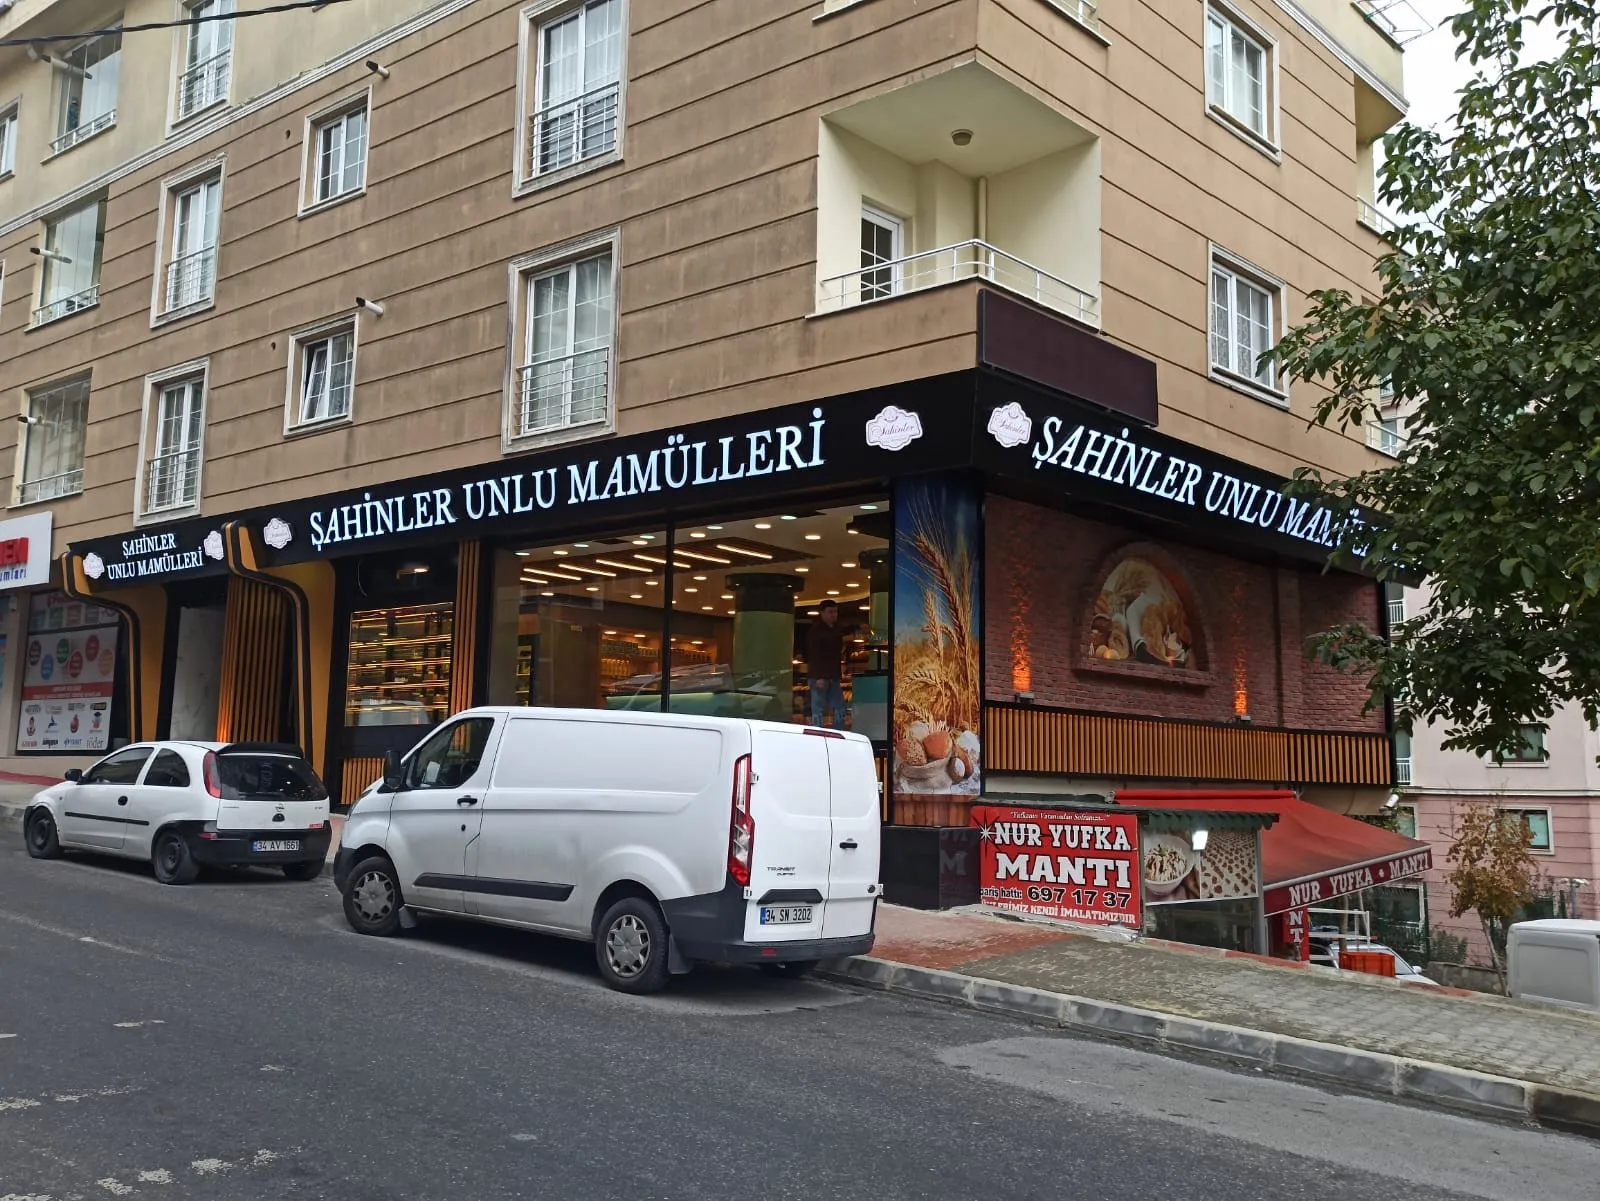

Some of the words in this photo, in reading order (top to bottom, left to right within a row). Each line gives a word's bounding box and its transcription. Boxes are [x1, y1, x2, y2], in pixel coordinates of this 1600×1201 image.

[310, 492, 458, 551] ŞAHİNLER
[462, 468, 557, 520] UNLU
[567, 407, 826, 504] MAMÜLLERİ
[1032, 416, 1203, 505] ŞAHİNLER
[1204, 471, 1282, 528] UNLU
[122, 533, 176, 559] ŞAHİNLER
[107, 562, 136, 580] UNLU
[137, 546, 203, 577] MAMÜLLERİ
[270, 840, 280, 851] AV
[994, 822, 1042, 847] NUR
[1049, 824, 1131, 851] YUFKA
[995, 852, 1131, 889] MANTI
[1289, 881, 1320, 907] NUR
[1330, 867, 1375, 896] YUFKA
[1388, 852, 1430, 879] MANTI
[1027, 885, 1067, 903] 697
[1071, 888, 1098, 907] 17
[1103, 890, 1131, 910] 37
[1030, 904, 1058, 916] KENDİ
[765, 908, 776, 922] 34
[779, 908, 790, 922] SN
[792, 907, 812, 921] 3202
